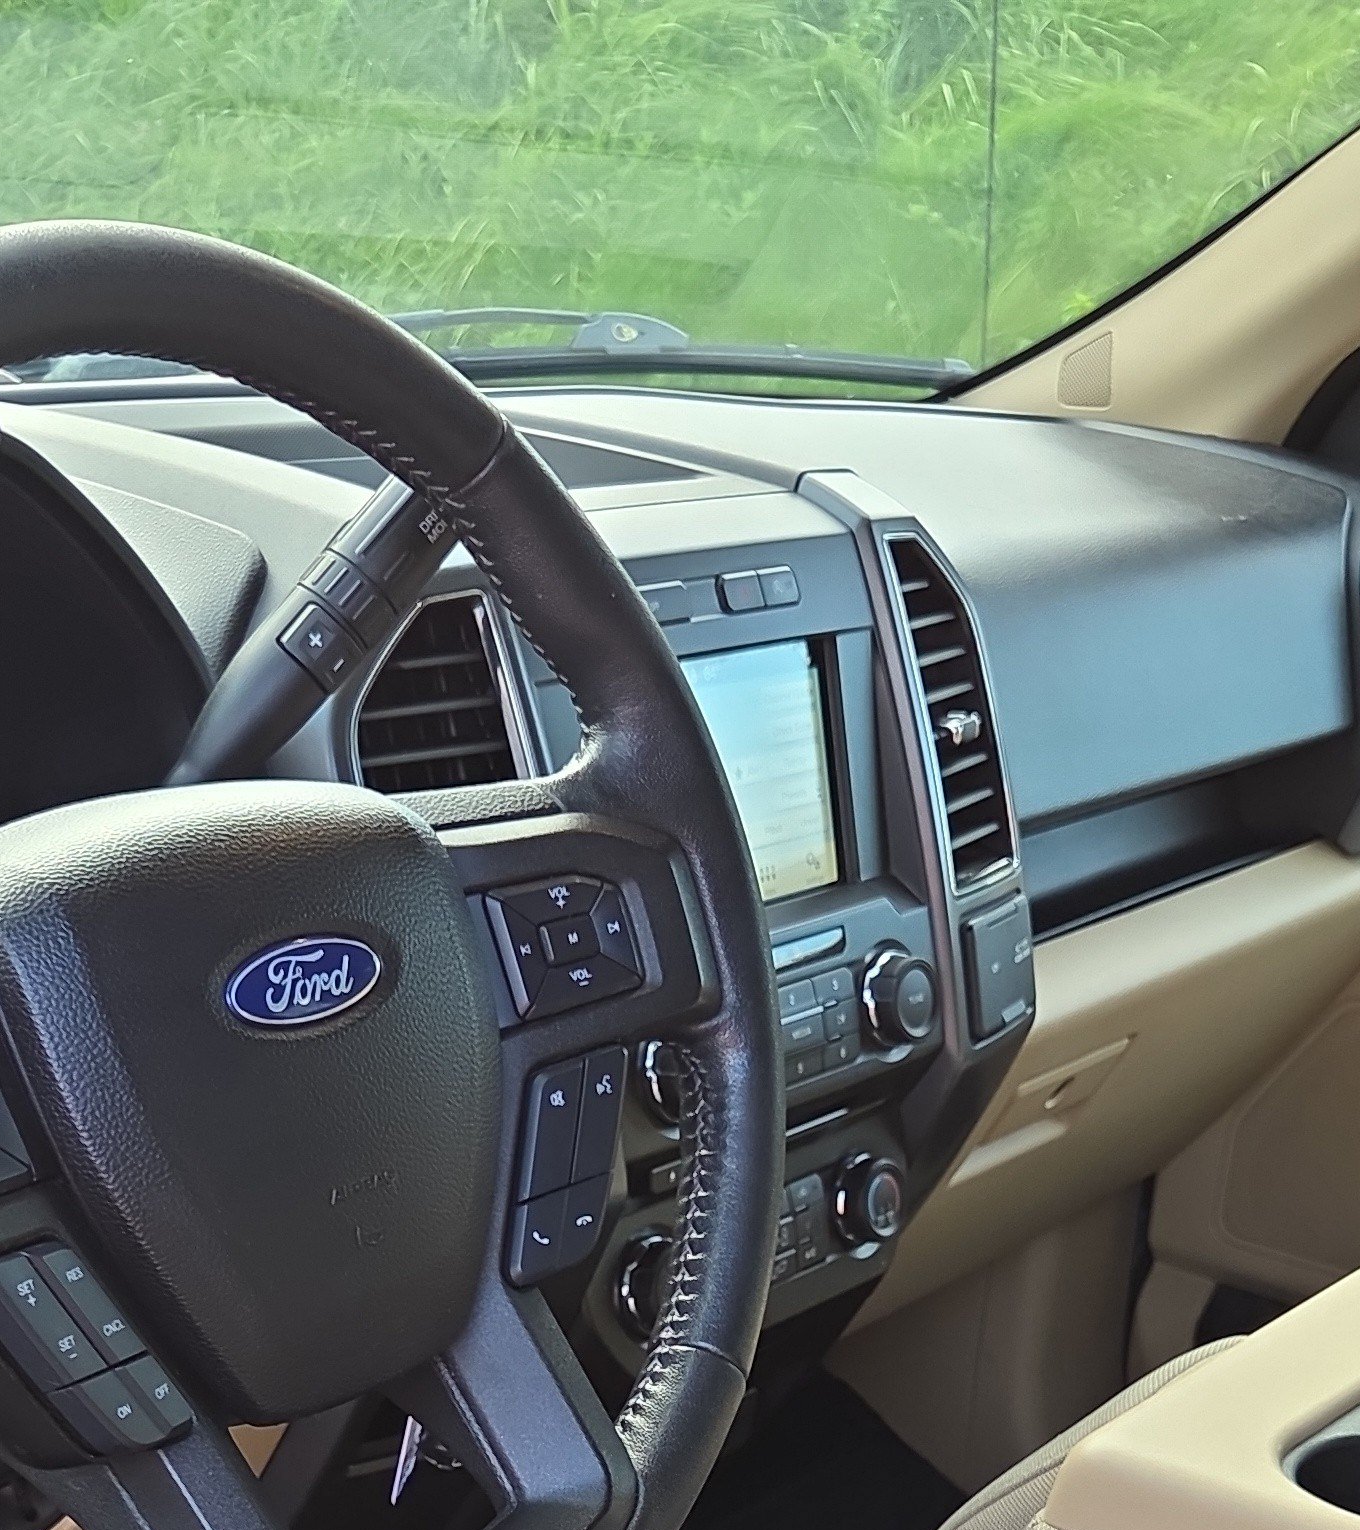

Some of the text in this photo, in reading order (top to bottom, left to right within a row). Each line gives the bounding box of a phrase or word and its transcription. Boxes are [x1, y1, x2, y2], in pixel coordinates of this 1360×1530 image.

[419, 508, 439, 534] DRI
[427, 519, 448, 544] MO
[547, 885, 571, 899] VOL
[567, 931, 579, 945] M
[265, 948, 355, 1013] Ford
[568, 967, 593, 982] VOL
[65, 1266, 85, 1283] RES
[16, 1278, 35, 1297] SET
[58, 1334, 76, 1353] SET
[154, 1382, 170, 1400] OFF
[116, 1403, 133, 1420] ON
